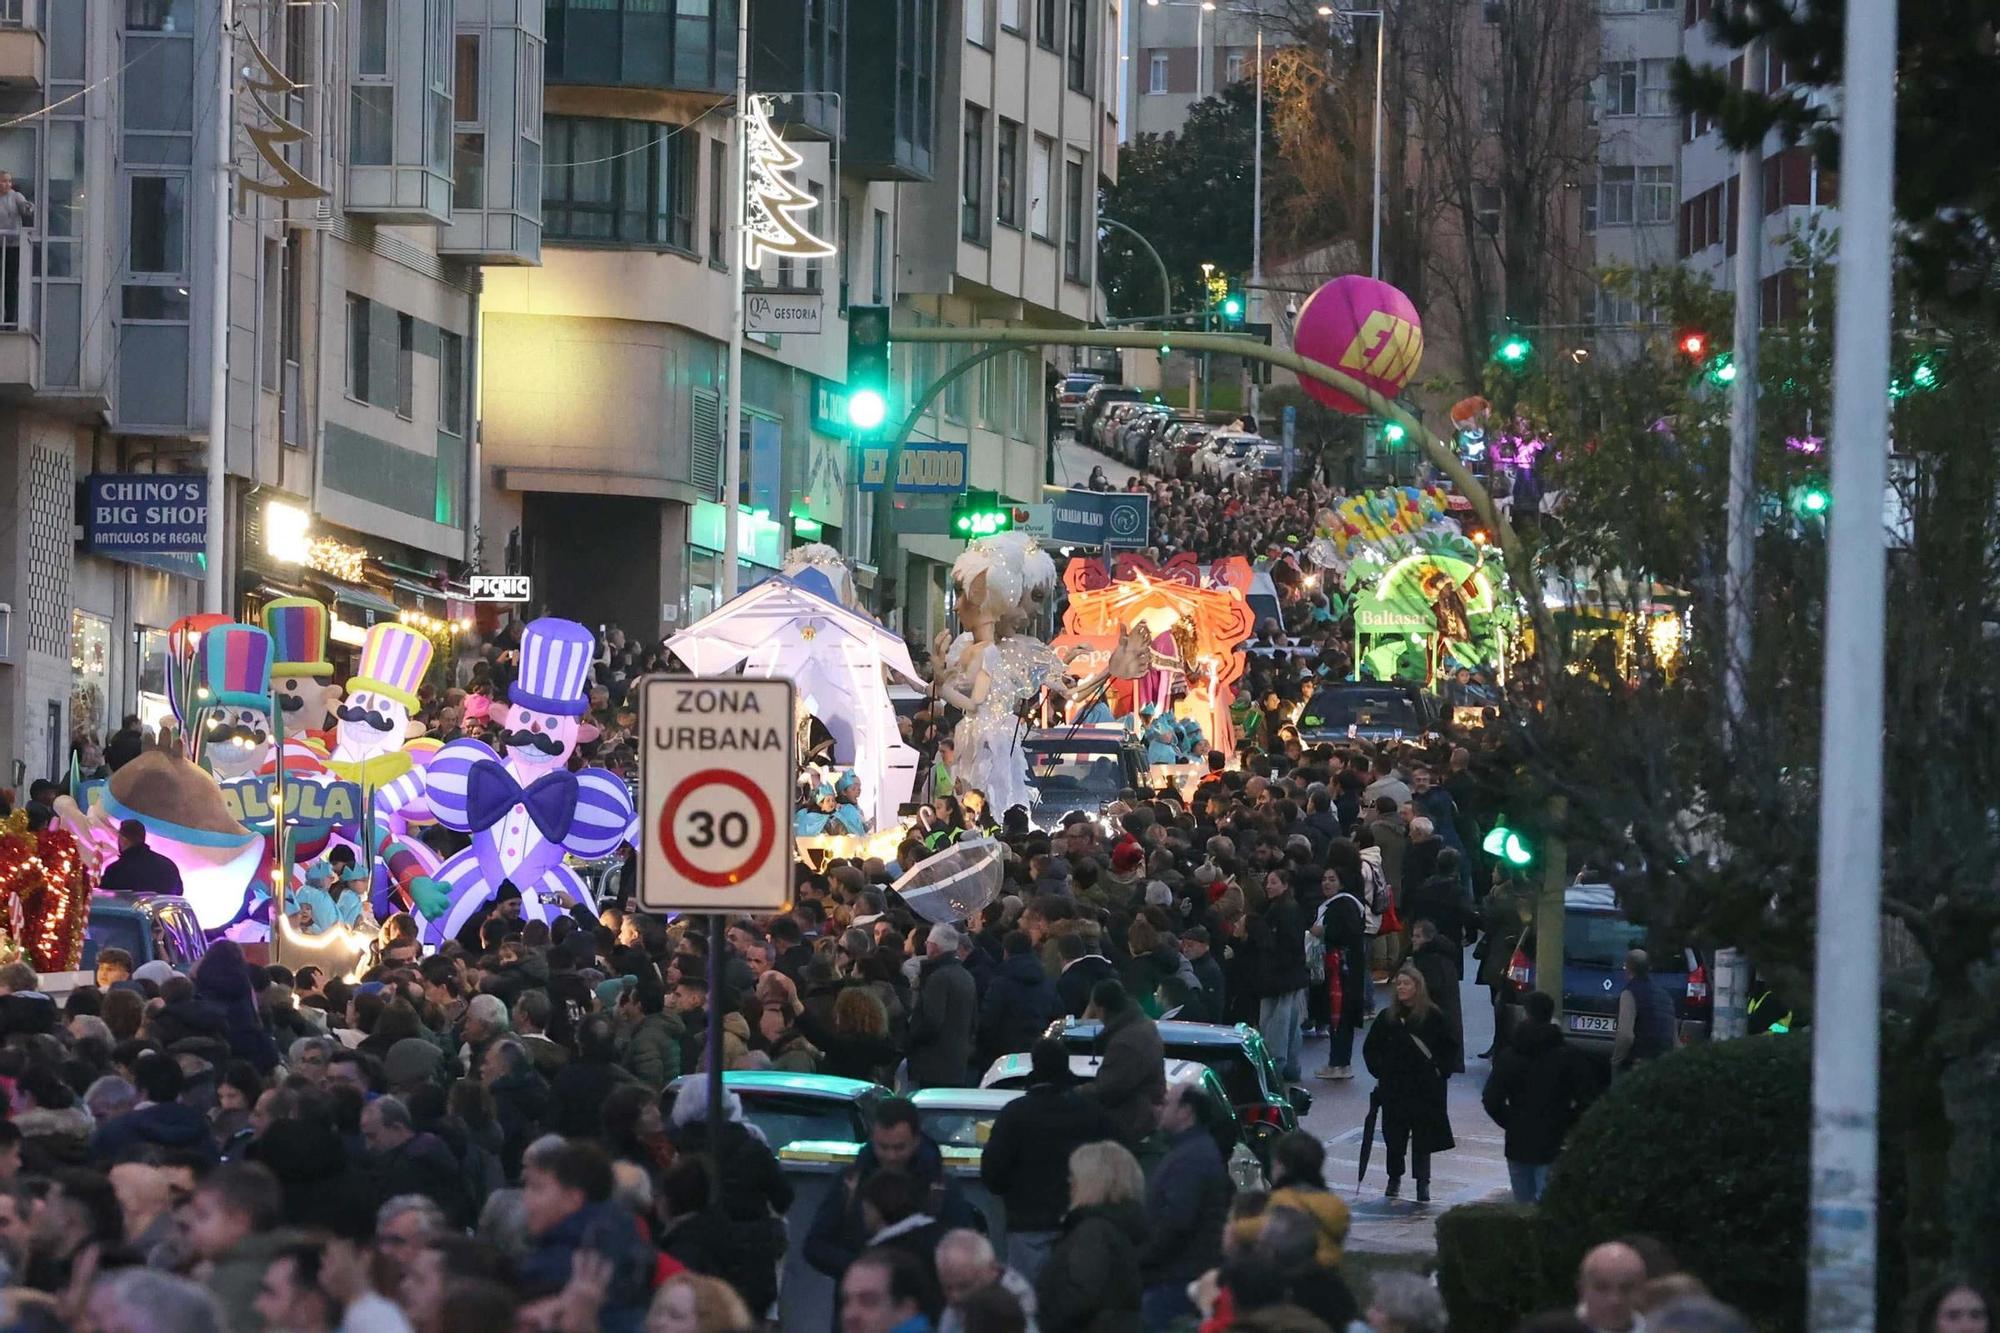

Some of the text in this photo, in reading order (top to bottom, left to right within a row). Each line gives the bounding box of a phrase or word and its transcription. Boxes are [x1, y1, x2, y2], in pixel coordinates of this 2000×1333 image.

[774, 308, 817, 320] GESTORIA
[100, 482, 200, 501] CHINO'S
[96, 506, 207, 524] BIG SHOP
[95, 532, 149, 544] ARTICULOS
[153, 532, 166, 544] DE
[473, 579, 527, 594] PICNIC
[1361, 610, 1429, 626] Baltasar
[676, 689, 760, 714] ZONA
[655, 727, 782, 751] URBANA
[686, 811, 749, 848] 30
[1582, 1017, 1609, 1030] 1792
